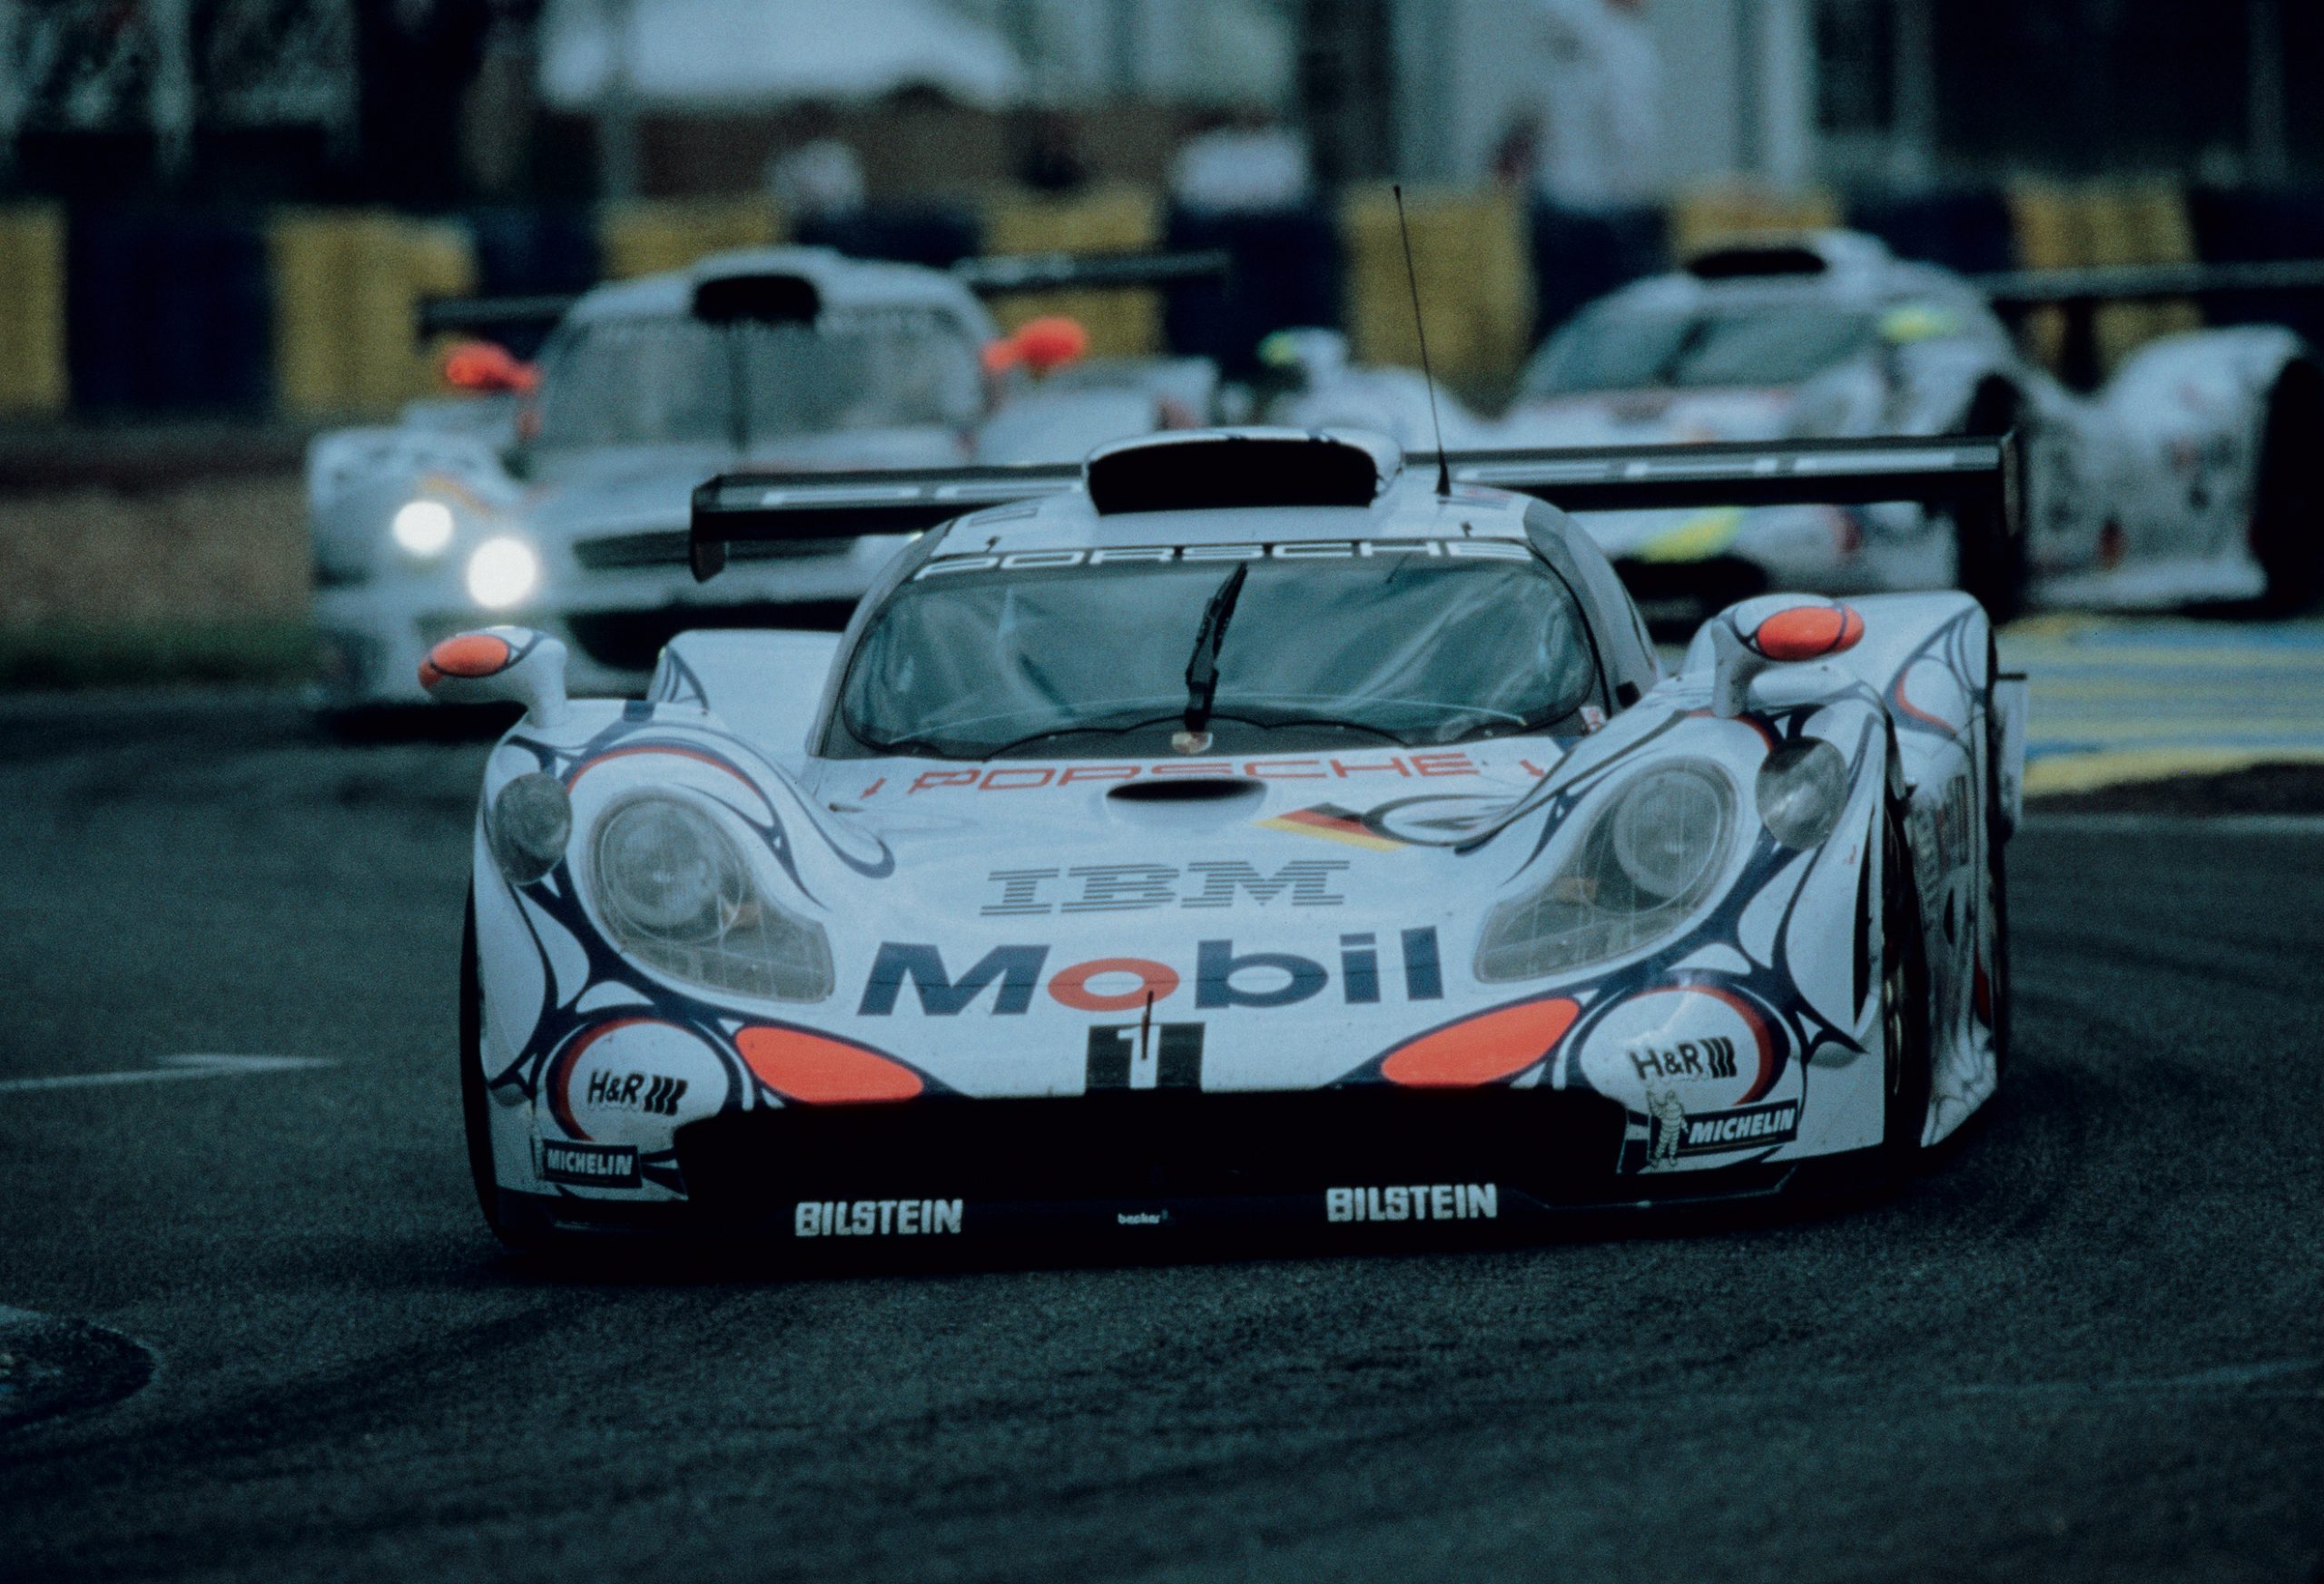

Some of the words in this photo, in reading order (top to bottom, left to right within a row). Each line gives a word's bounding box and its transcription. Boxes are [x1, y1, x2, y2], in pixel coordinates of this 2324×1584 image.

[913, 541, 1534, 581] PORSCHE
[907, 752, 1481, 795] PORSCHE
[980, 860, 1351, 917] IBM
[857, 926, 1445, 1017] Mobil
[1117, 1024, 1161, 1090] 1
[1630, 1043, 1704, 1080] H&R
[586, 1070, 645, 1105] H&R
[1687, 1107, 1797, 1145] MICHELIN
[547, 1148, 634, 1176] MICHELIN
[794, 1199, 964, 1238] BILSTEIN
[1325, 1183, 1498, 1223] BILSTEIN
